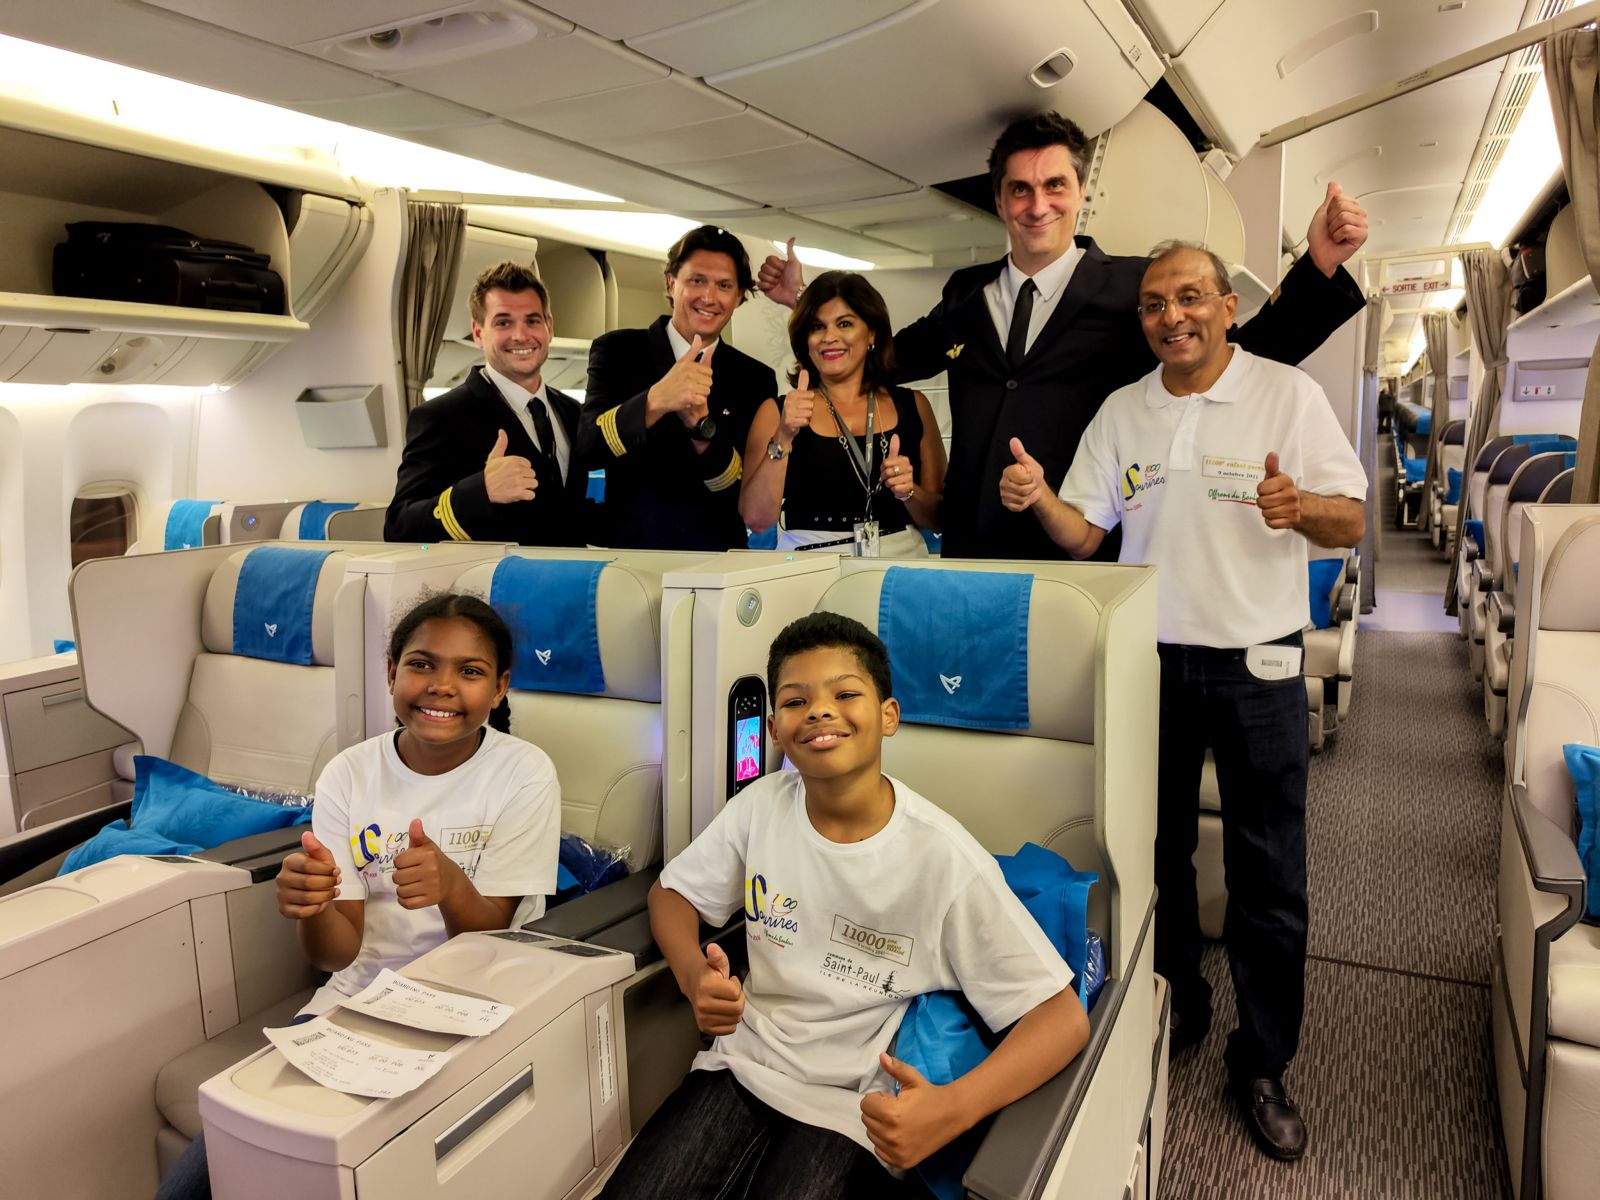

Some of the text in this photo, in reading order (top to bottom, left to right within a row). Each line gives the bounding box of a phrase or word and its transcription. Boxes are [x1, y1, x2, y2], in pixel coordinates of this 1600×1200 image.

[1392, 281, 1438, 293] SORTIE EXIT
[841, 923, 887, 950] 11000
[823, 956, 880, 985] Saint-Paul
